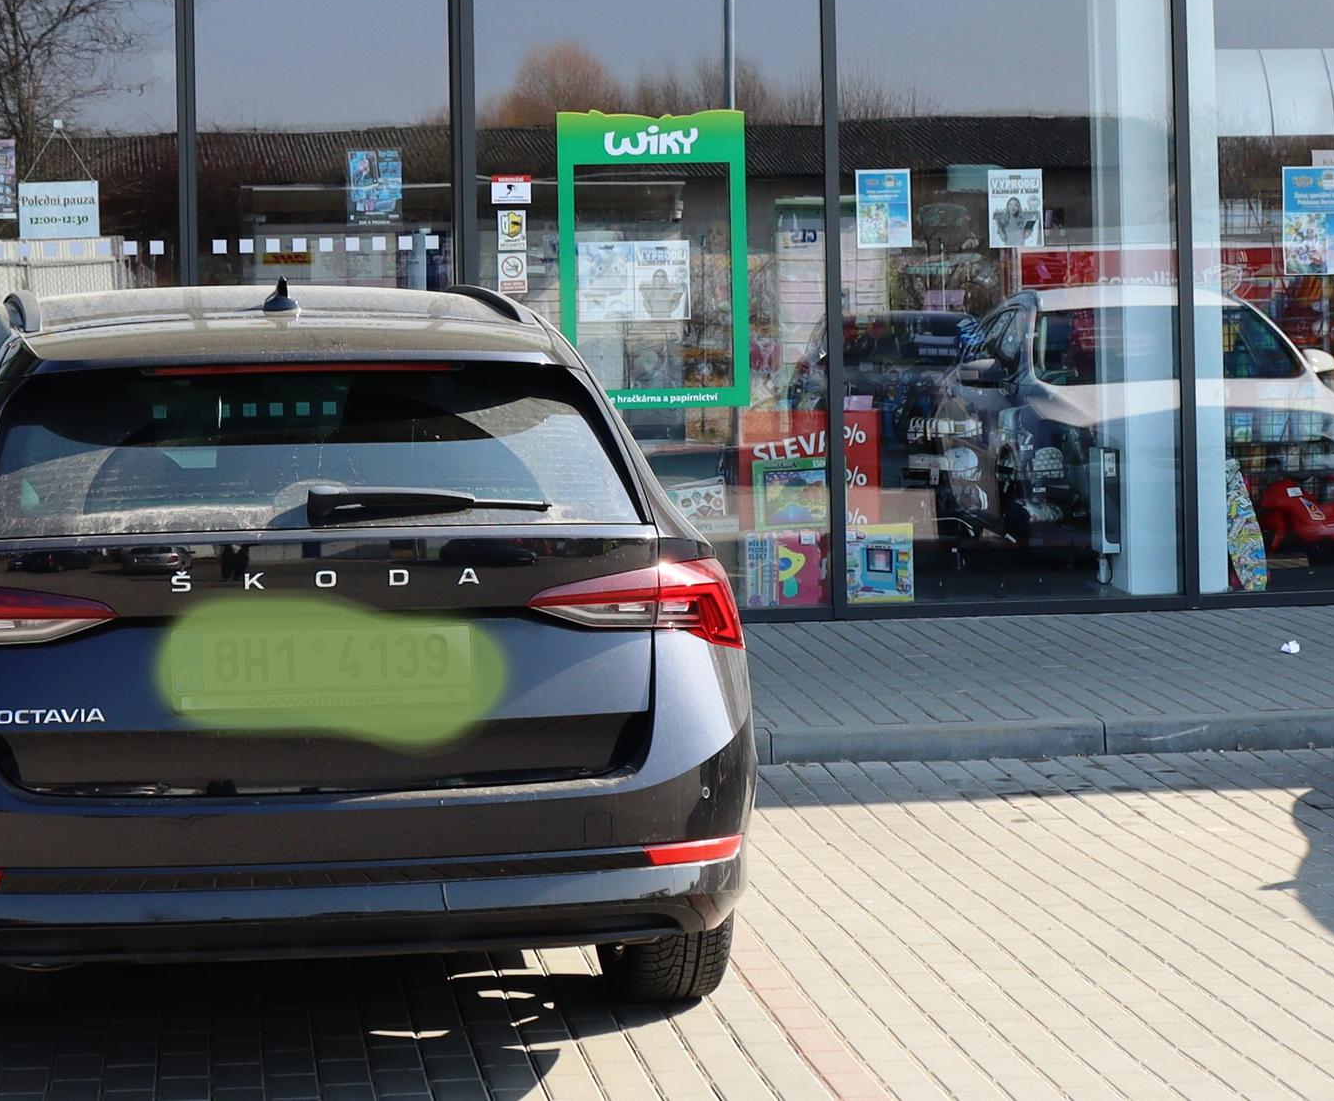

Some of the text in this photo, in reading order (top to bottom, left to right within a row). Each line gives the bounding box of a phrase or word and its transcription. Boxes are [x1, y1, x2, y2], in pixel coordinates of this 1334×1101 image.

[21, 195, 96, 208] Polední pauza
[617, 394, 661, 403] hračkárna
[670, 392, 718, 403] papírnictví
